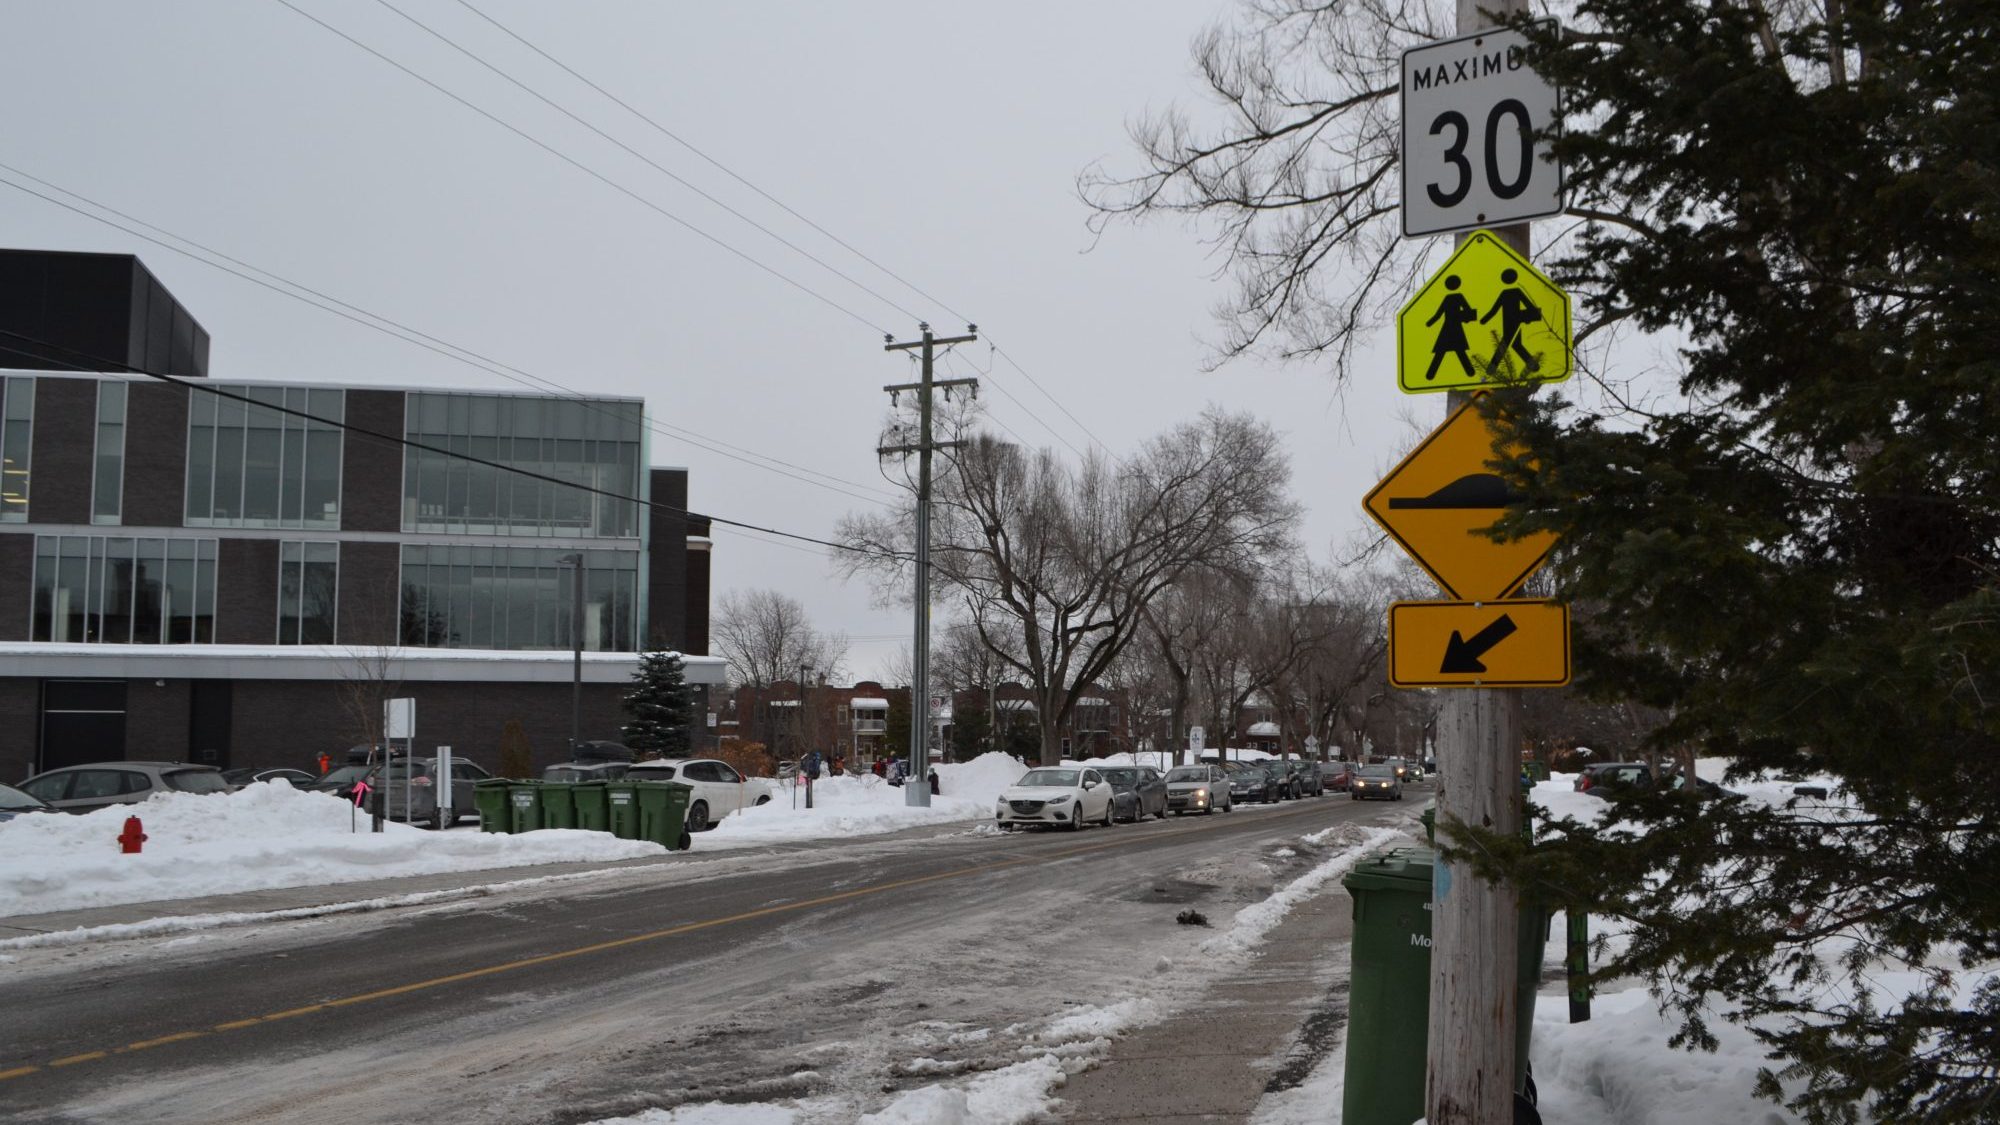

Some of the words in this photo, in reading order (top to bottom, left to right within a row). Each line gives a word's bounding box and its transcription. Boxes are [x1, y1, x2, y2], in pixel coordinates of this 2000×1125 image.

[1413, 44, 1523, 91] MAXIMU
[1426, 98, 1534, 208] 30
[1410, 933, 1432, 948] Mo
